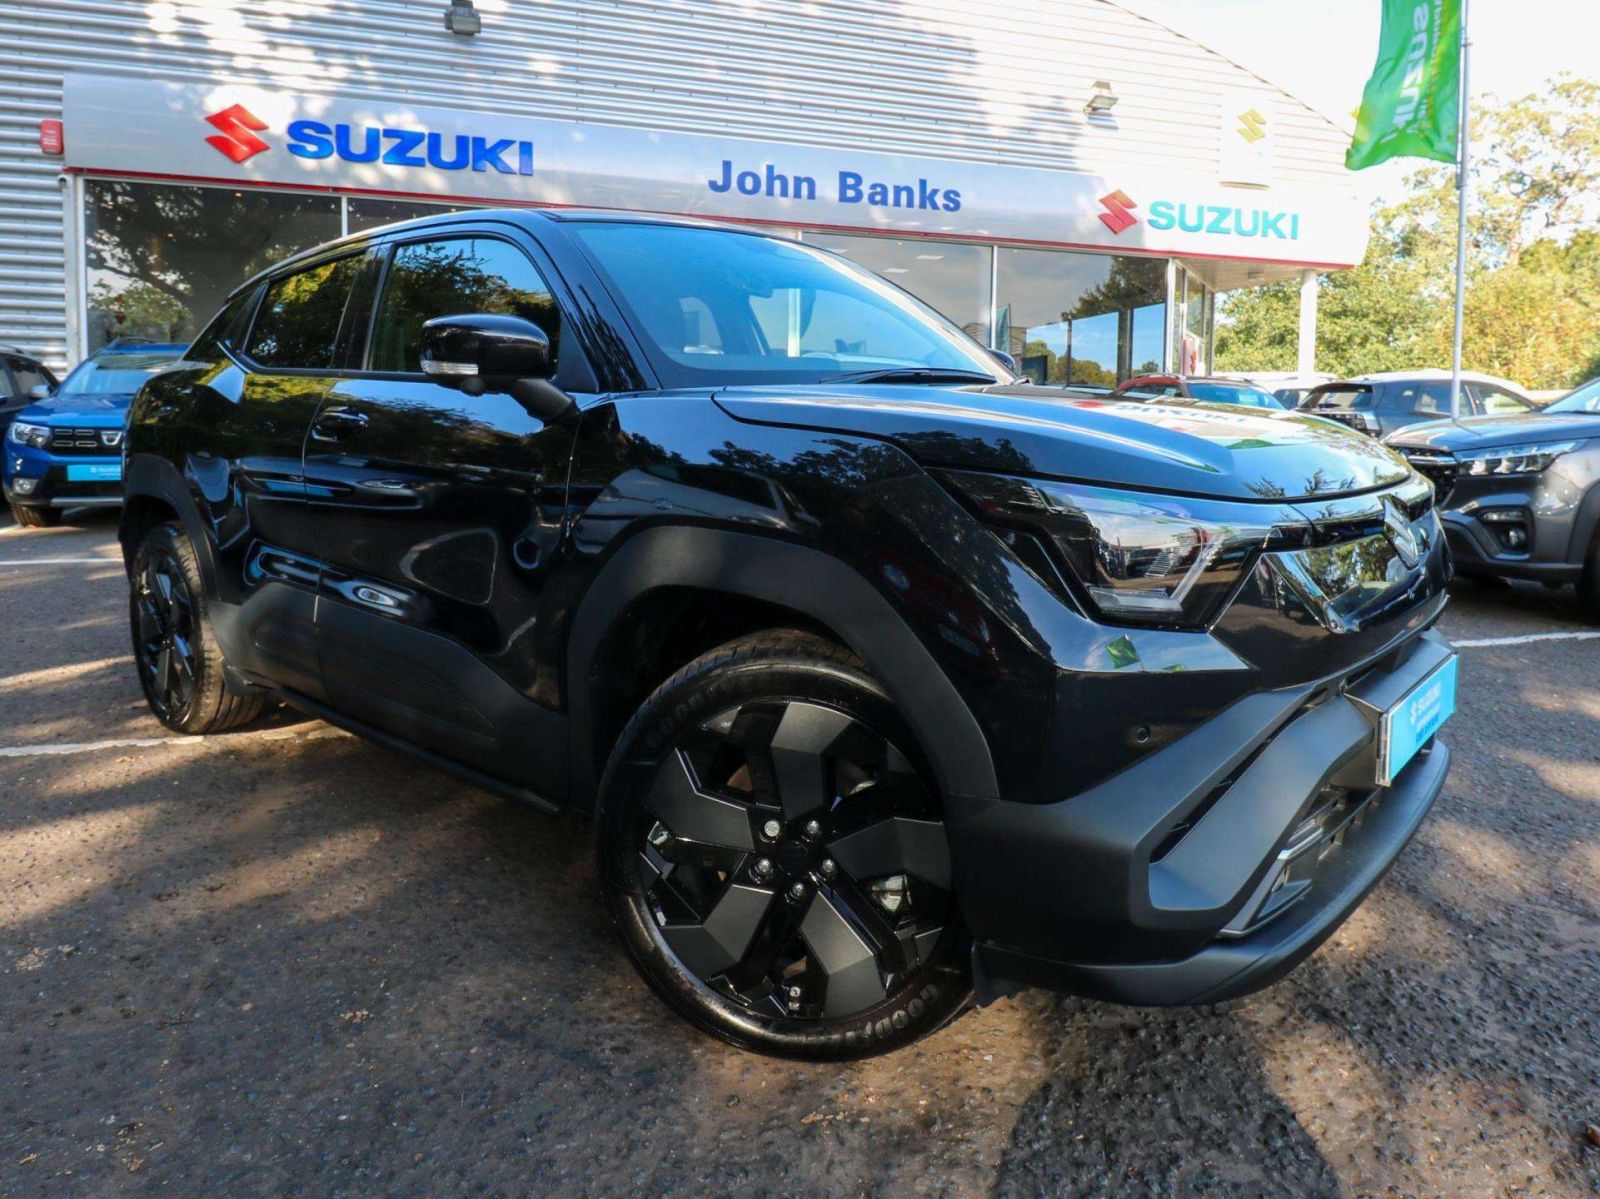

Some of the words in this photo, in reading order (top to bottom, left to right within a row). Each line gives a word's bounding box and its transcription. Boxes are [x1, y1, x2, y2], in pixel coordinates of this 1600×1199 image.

[286, 120, 533, 176] SUZUKI
[708, 160, 816, 200] John
[838, 171, 962, 212] Banks
[1147, 200, 1299, 240] SUZUKI
